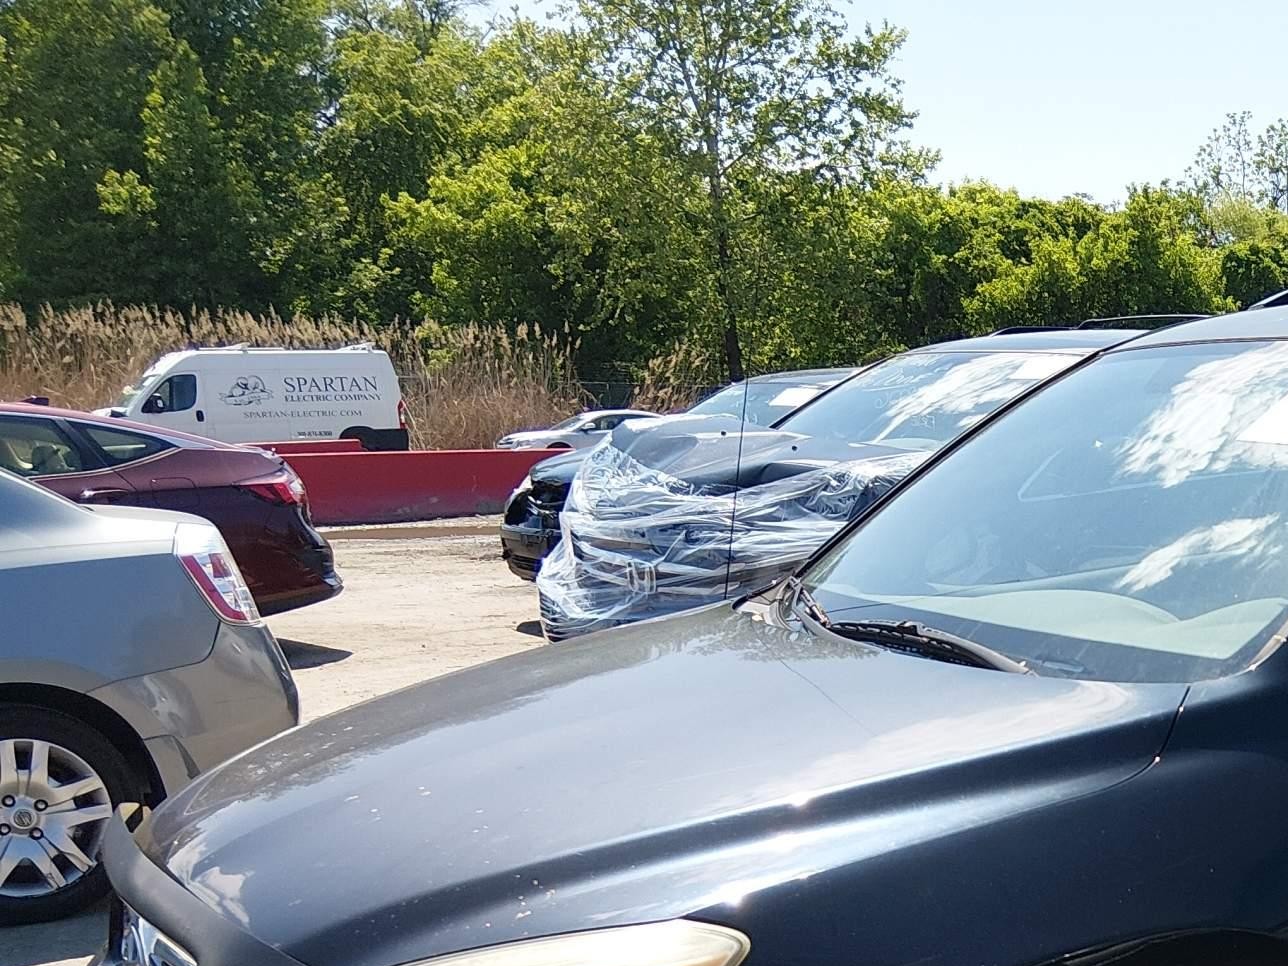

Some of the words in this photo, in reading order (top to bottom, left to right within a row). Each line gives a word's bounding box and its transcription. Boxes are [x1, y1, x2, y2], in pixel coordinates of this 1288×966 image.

[283, 376, 378, 392] SPARTAN
[284, 394, 333, 402] ELECTRIC
[334, 393, 382, 401] COMPANY
[243, 410, 362, 418] SPARTAN-ELECTRICCOM
